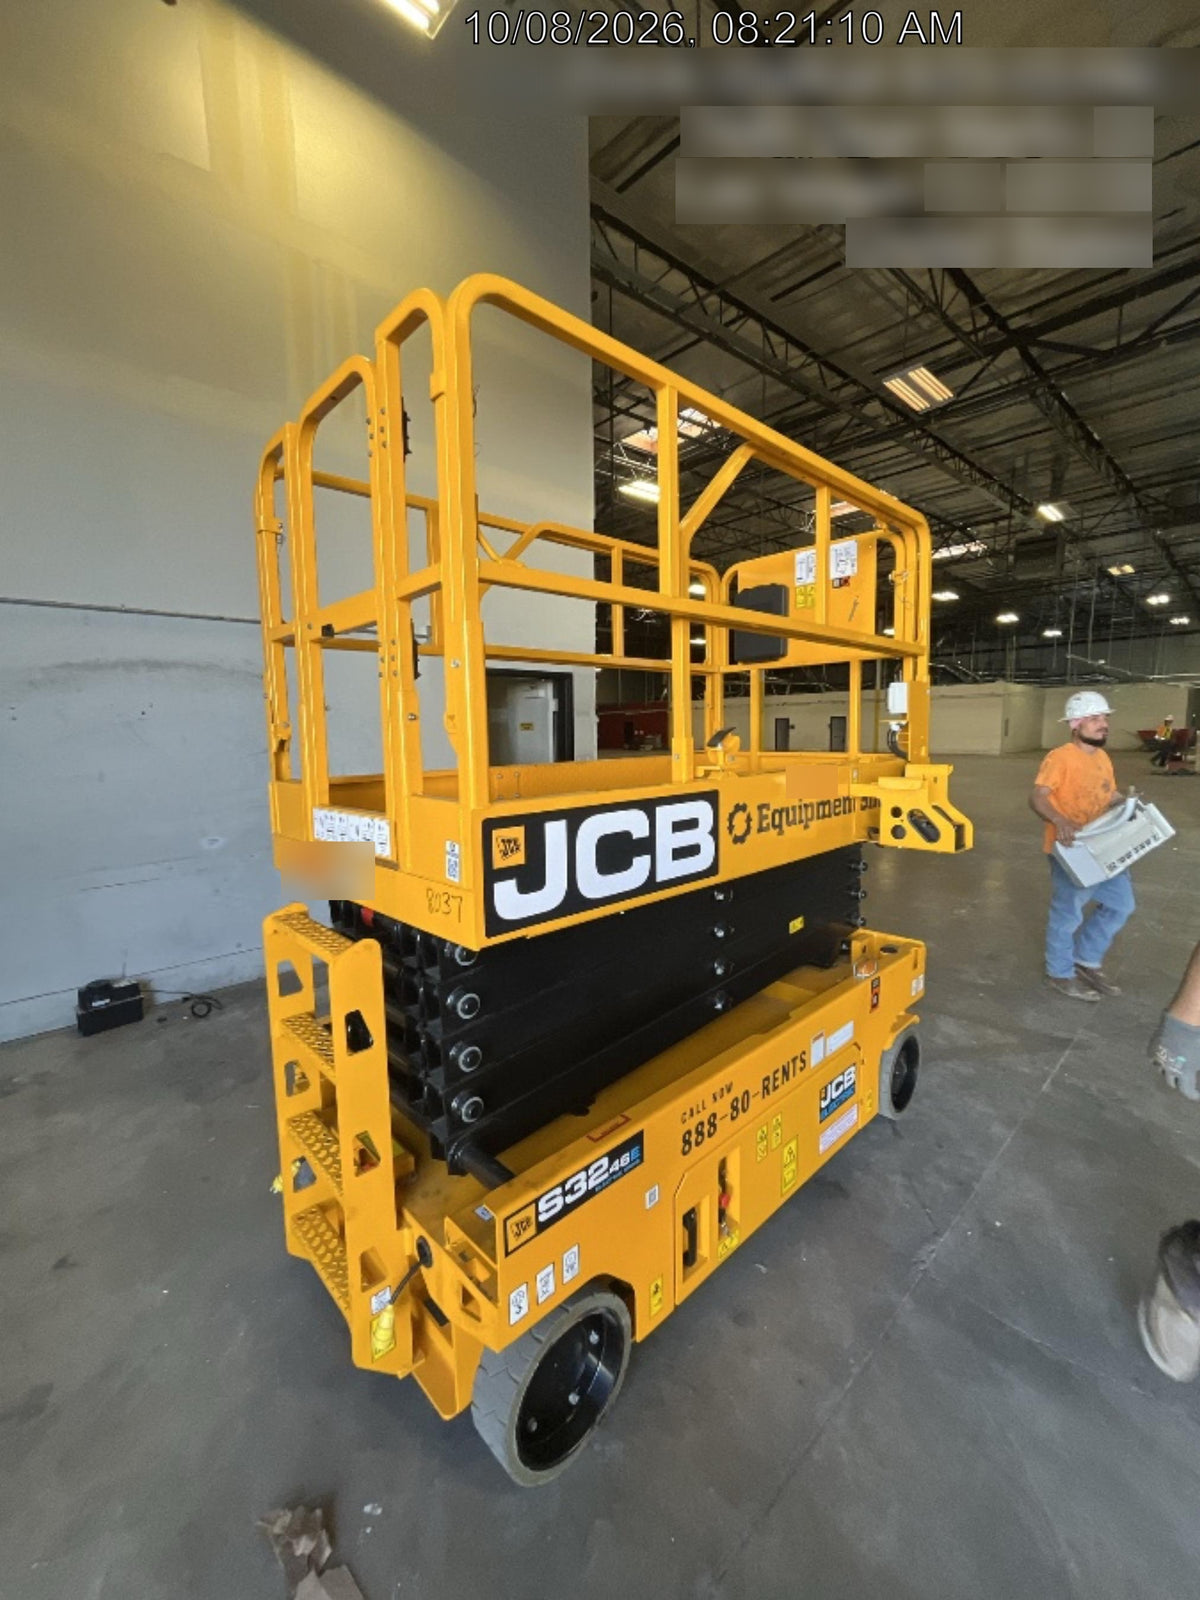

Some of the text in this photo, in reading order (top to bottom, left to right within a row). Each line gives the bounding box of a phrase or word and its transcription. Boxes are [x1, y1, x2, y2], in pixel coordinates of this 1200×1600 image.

[493, 799, 716, 921] JCB
[426, 888, 463, 924] 8037
[681, 1081, 733, 1125] CALL NOW
[681, 1050, 806, 1156] 888-80-RENTS
[820, 1066, 856, 1109] JCB
